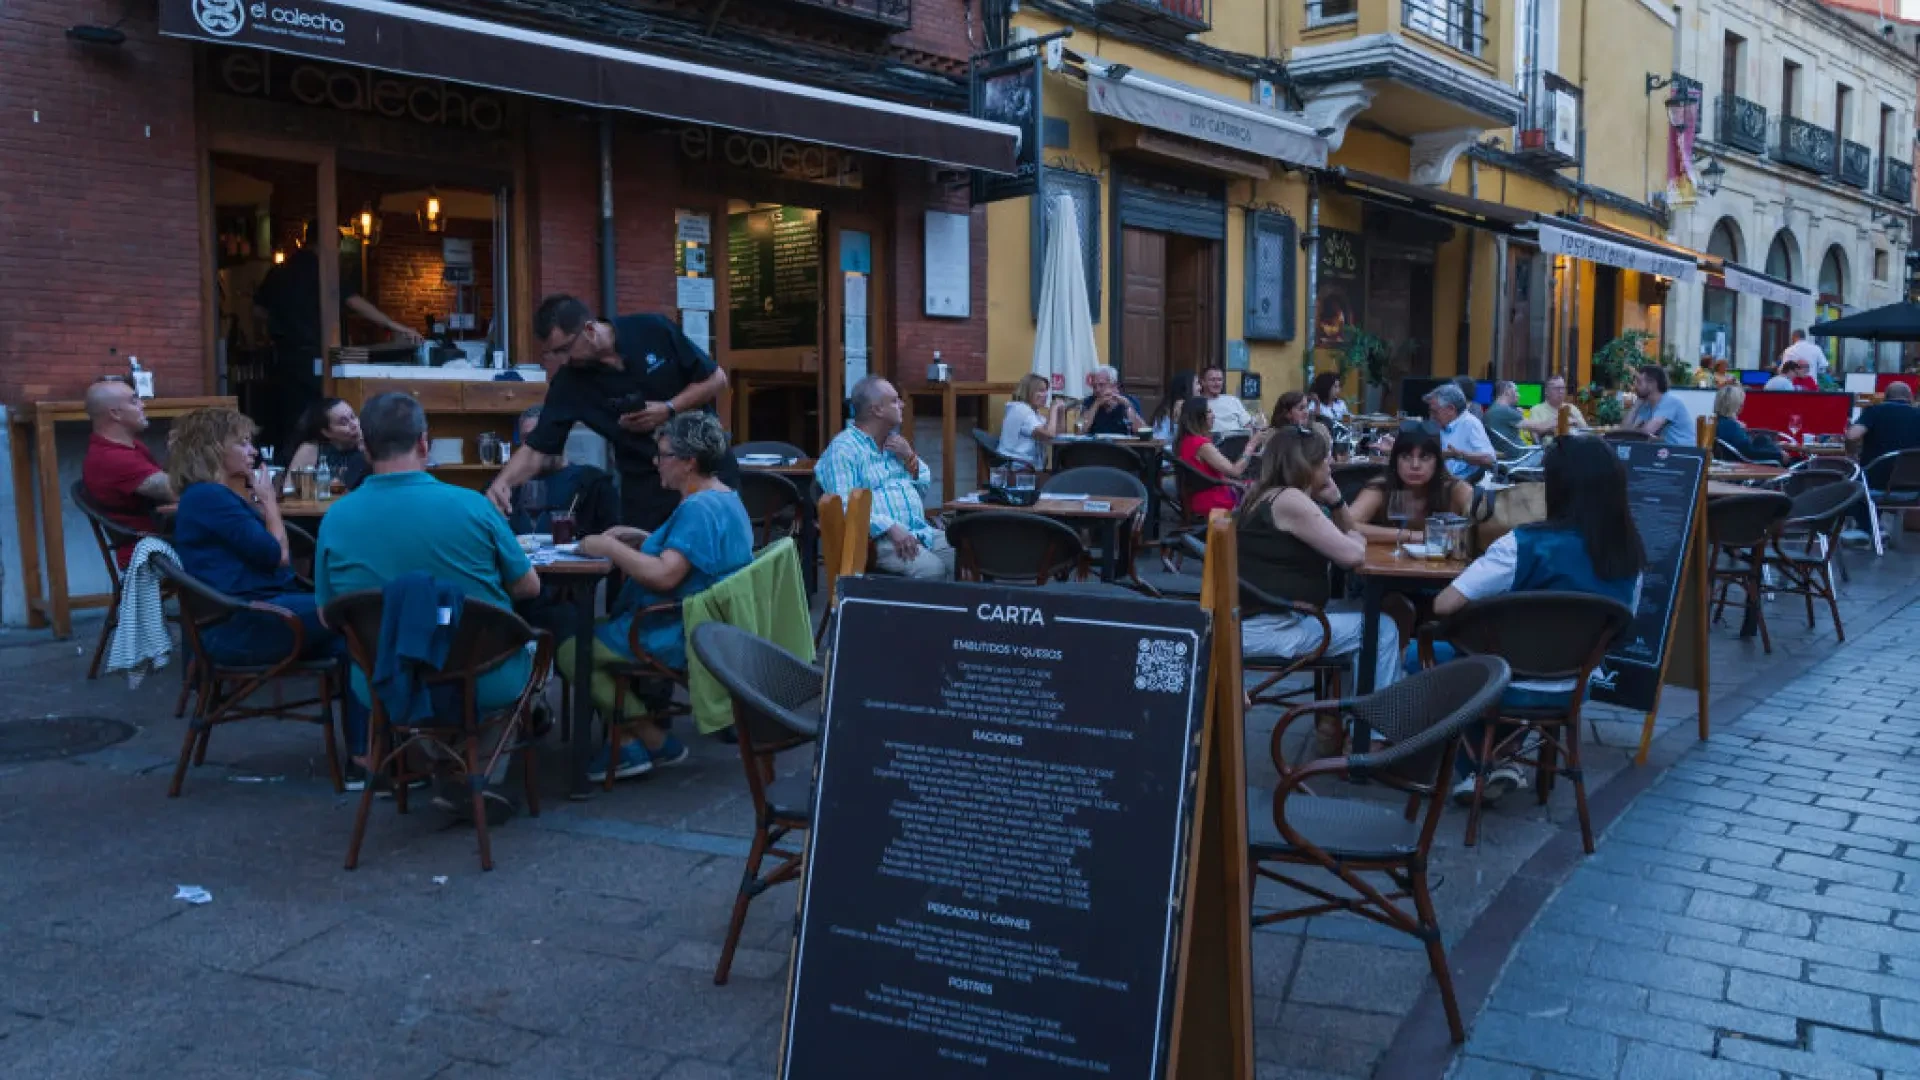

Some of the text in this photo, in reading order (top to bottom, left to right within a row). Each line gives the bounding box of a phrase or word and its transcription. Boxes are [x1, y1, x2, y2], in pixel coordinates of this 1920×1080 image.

[250, 1, 345, 33] el calecho
[224, 51, 502, 130] el calecho
[680, 125, 714, 161] el
[976, 603, 1045, 626] CARTA
[953, 639, 1062, 661] EMBUTIDOS Y QUESOS
[972, 729, 1024, 747] RACIONES
[926, 900, 979, 921] PESCADOS
[989, 913, 1032, 932] CARNES
[948, 976, 994, 996] POSTRES
